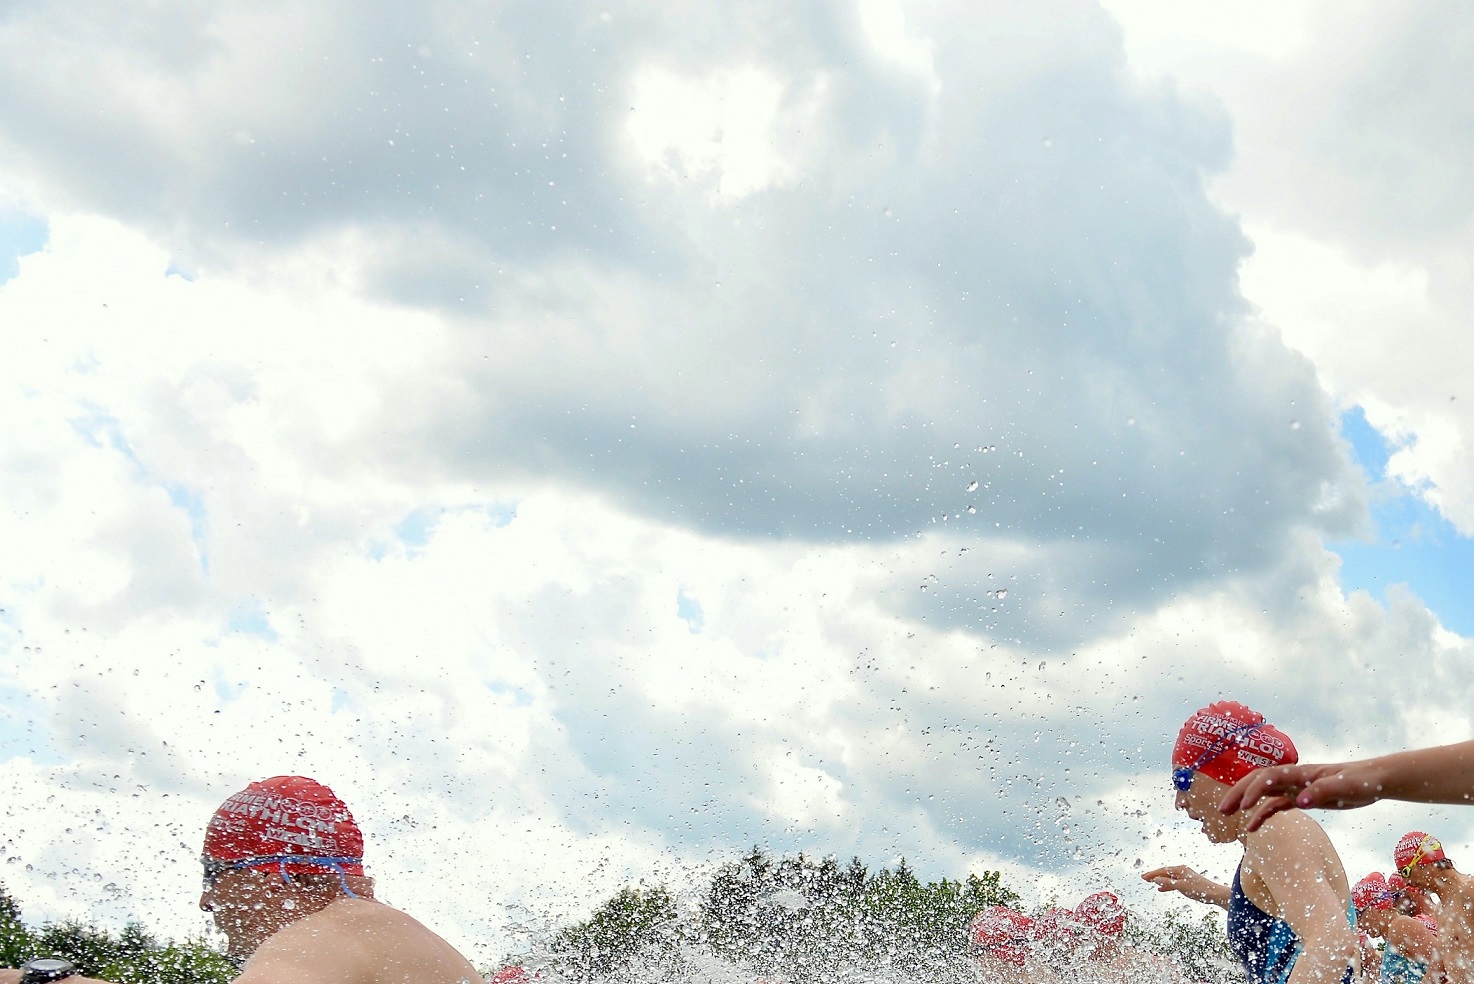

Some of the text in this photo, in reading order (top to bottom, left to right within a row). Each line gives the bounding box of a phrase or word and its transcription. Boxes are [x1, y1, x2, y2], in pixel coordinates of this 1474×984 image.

[1196, 715, 1249, 735] FIRMEN
[1184, 733, 1212, 747] Sport
[1240, 750, 1268, 766] WKS
[231, 792, 282, 810] RMEN
[220, 800, 335, 834] RIATHLON
